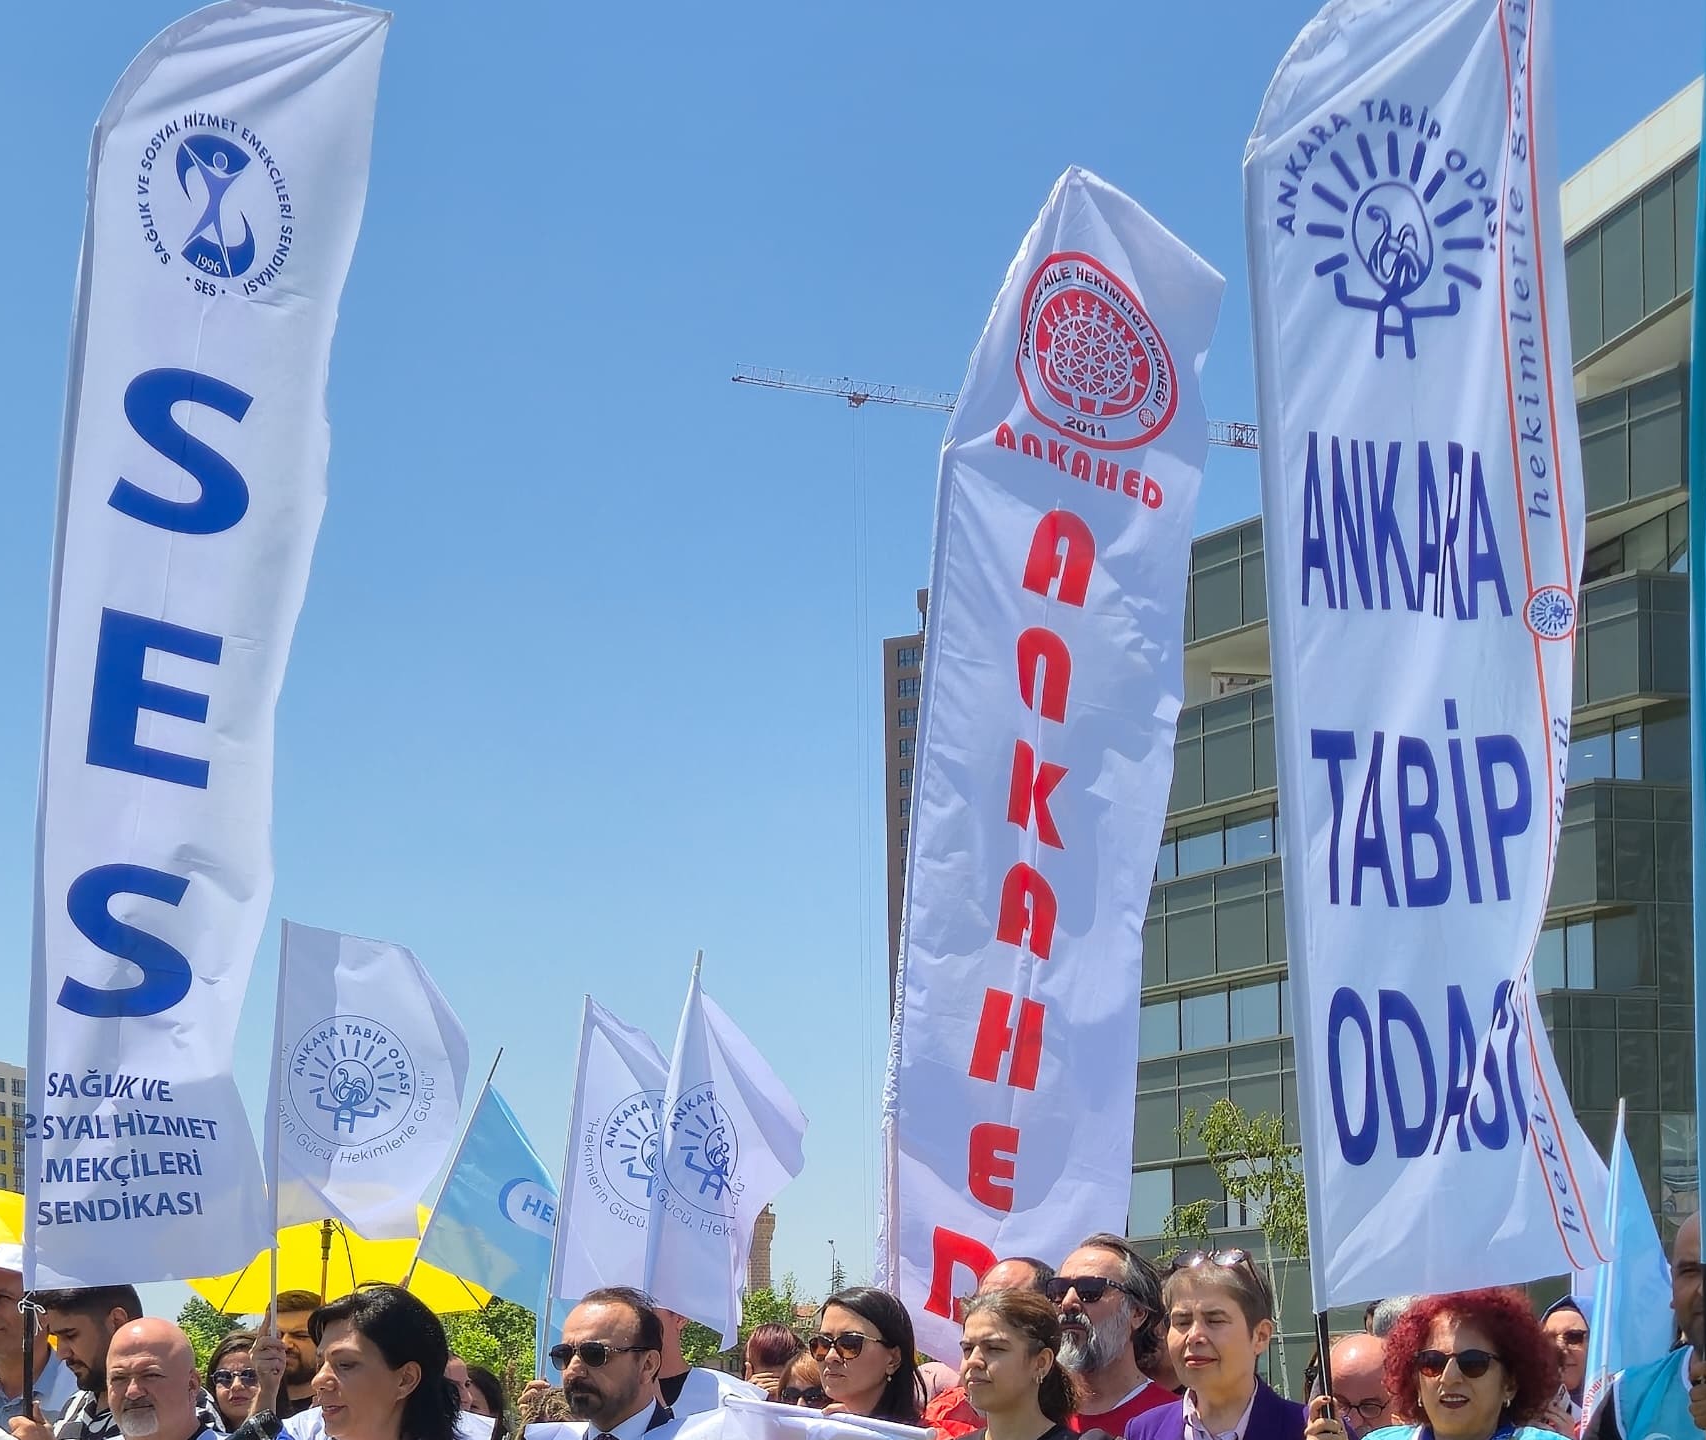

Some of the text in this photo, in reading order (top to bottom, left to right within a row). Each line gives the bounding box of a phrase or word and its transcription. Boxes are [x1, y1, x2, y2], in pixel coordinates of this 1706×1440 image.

[141, 119, 181, 171] SOSYAL
[184, 110, 237, 133] HİZMET
[137, 174, 150, 195] VE
[1275, 111, 1352, 236] ANKARA
[1360, 99, 1442, 142] TABİP
[138, 201, 171, 264] SAĞLIK
[195, 253, 222, 275] 1996
[243, 225, 294, 296] SENDİKASI
[1076, 266, 1148, 331] HEKİMLİĞİ
[1145, 336, 1170, 411] DERNEĞİ
[1505, 185, 1552, 521] hekimlerle
[1063, 416, 1107, 438] 2011
[995, 422, 1164, 510] ANKAHED
[1302, 431, 1513, 620] ANKARA
[1311, 698, 1531, 907] TABİP
[47, 1069, 173, 1102] SAĞLIK VE
[294, 1024, 411, 1097] ANKARA TABİP ODASI
[33, 1109, 218, 1141] SYAL HİZMET
[605, 1099, 651, 1149] ANKARA
[669, 1089, 717, 1132] ANKAR
[41, 1149, 203, 1187] MEKÇİLERİ
[339, 1125, 418, 1164] Hekimlerle
[37, 1191, 204, 1226] SENDİKASI
